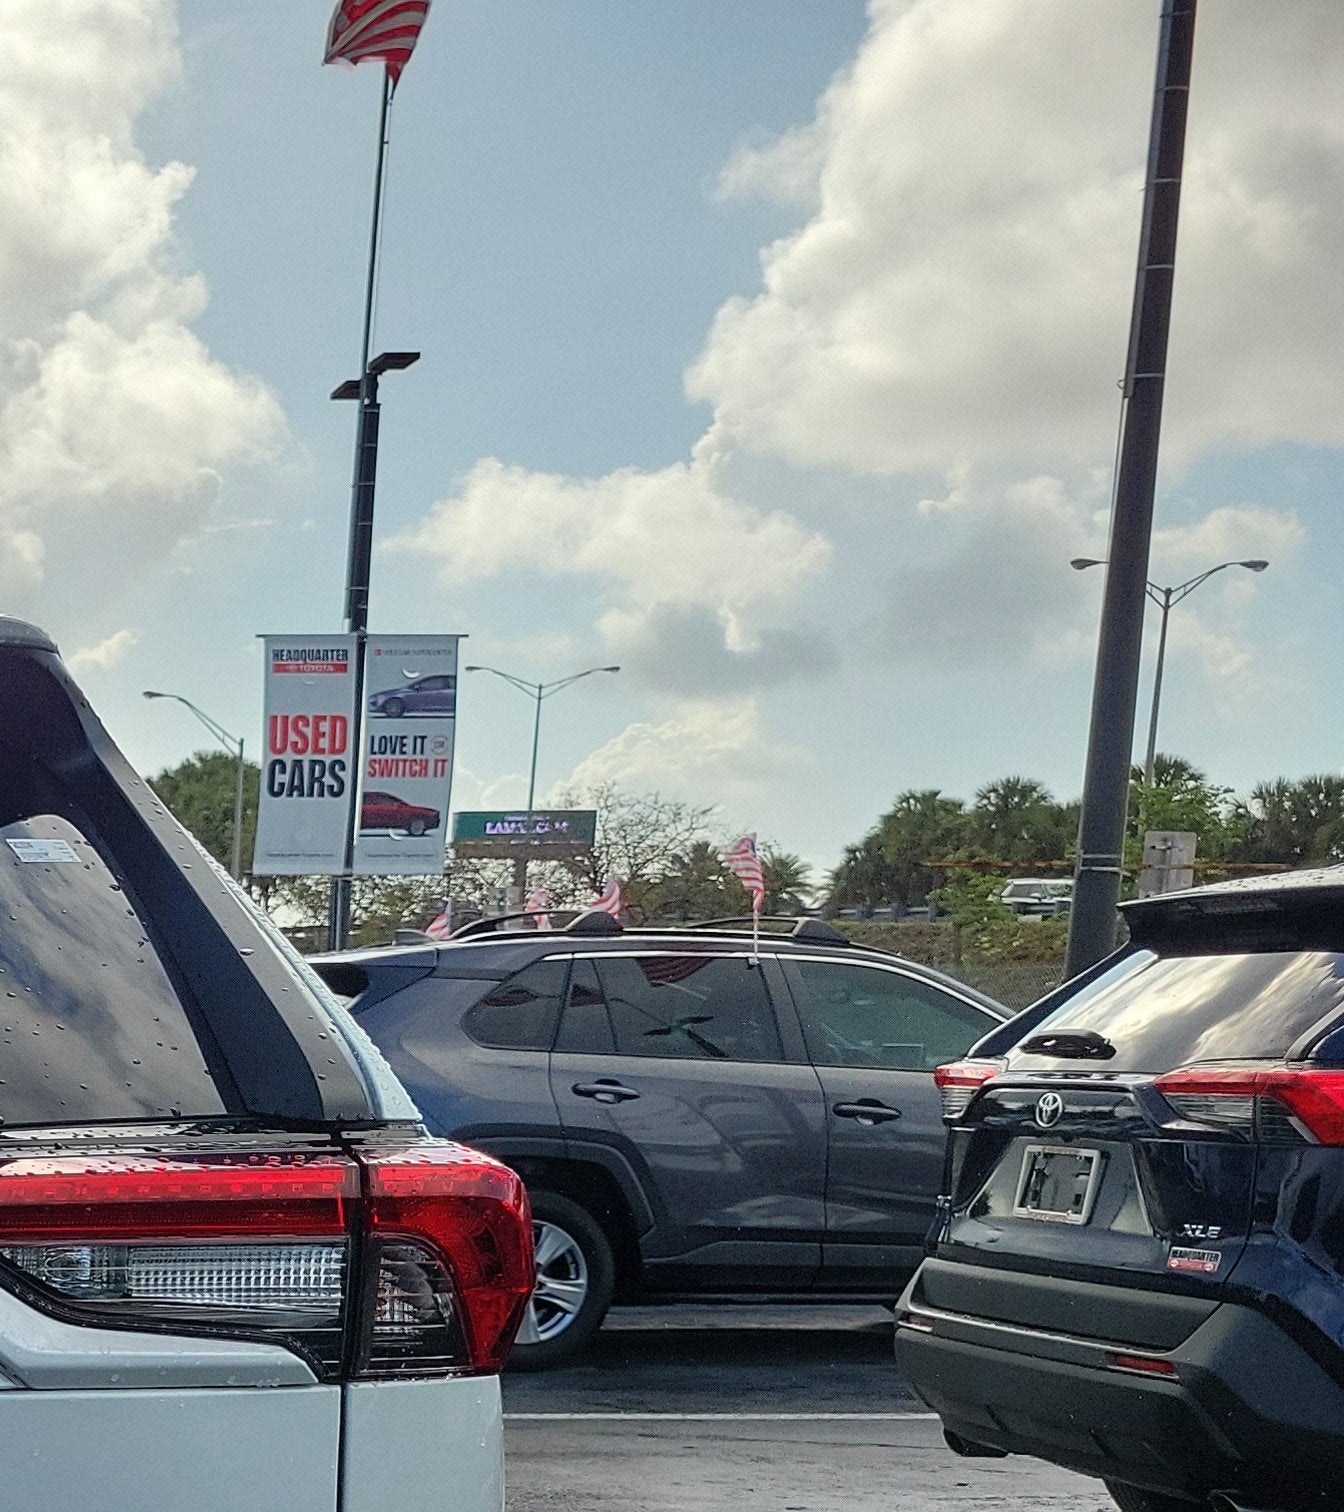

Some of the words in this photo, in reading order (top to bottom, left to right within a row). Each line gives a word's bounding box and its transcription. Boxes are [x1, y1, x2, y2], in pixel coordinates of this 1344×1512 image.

[272, 648, 349, 663] HEADQUARTER
[268, 714, 348, 755] USED
[370, 735, 408, 755] LOVE
[413, 735, 428, 755] IT
[367, 758, 429, 778] SWITCH
[433, 758, 448, 778] IT
[267, 759, 346, 798] CARS
[1176, 1224, 1222, 1239] XLE
